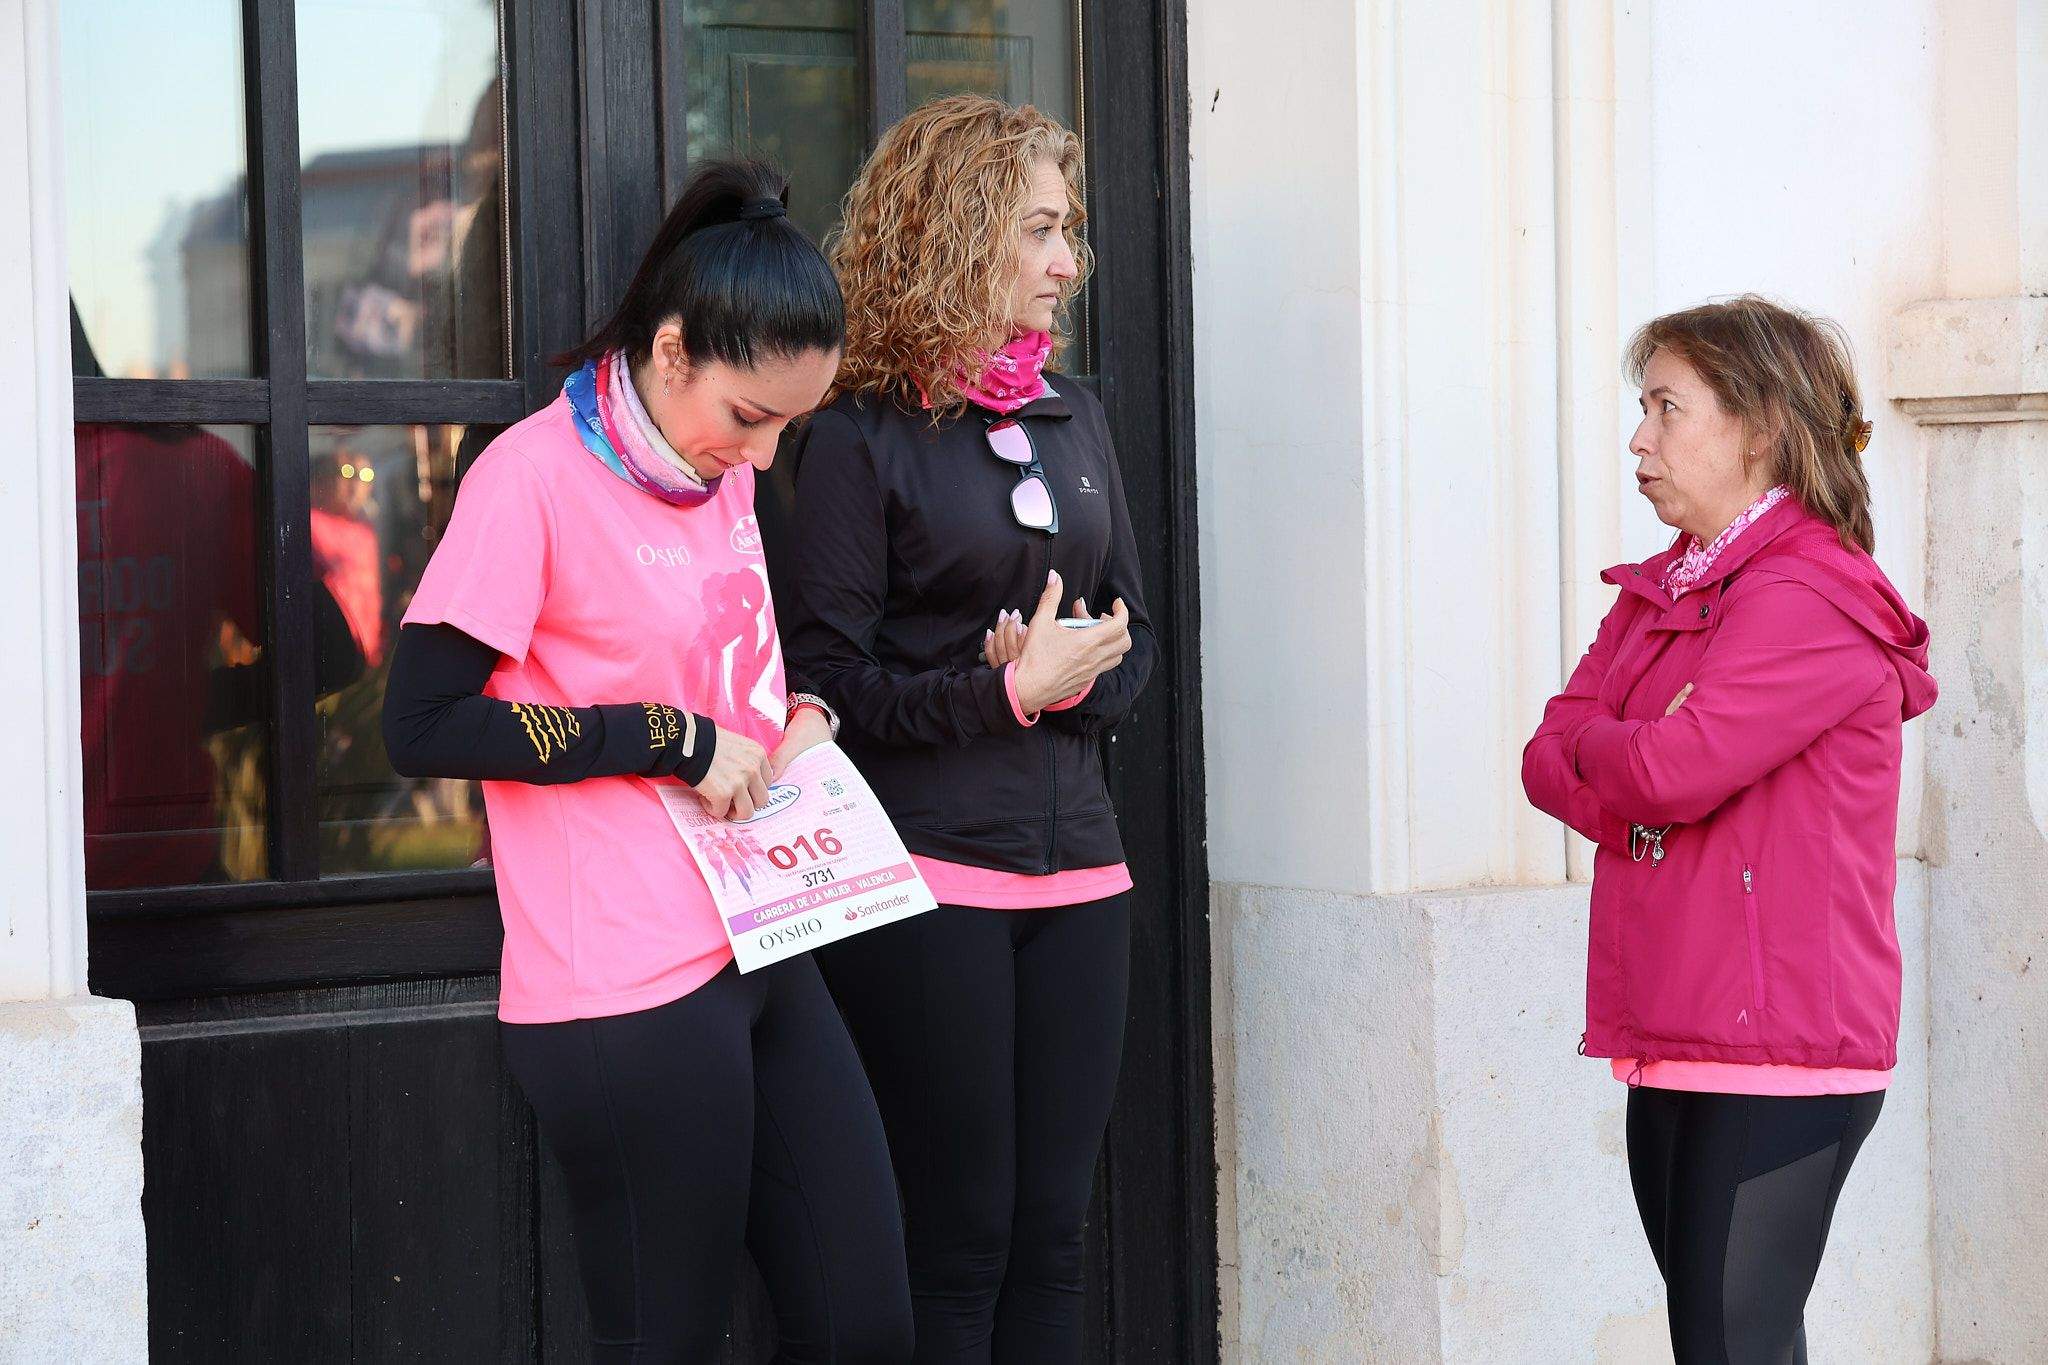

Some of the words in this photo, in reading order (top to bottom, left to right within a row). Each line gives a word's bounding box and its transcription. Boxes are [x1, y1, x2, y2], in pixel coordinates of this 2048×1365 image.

[767, 828, 843, 870] 016
[753, 900, 796, 924] CARRERA
[798, 895, 811, 908] DE
[811, 892, 822, 905] LA
[824, 884, 851, 901] MUJER
[856, 872, 896, 891] VALENCIA
[802, 868, 835, 888] 3731
[759, 917, 822, 950] OYSHO
[857, 892, 910, 917] Santander
